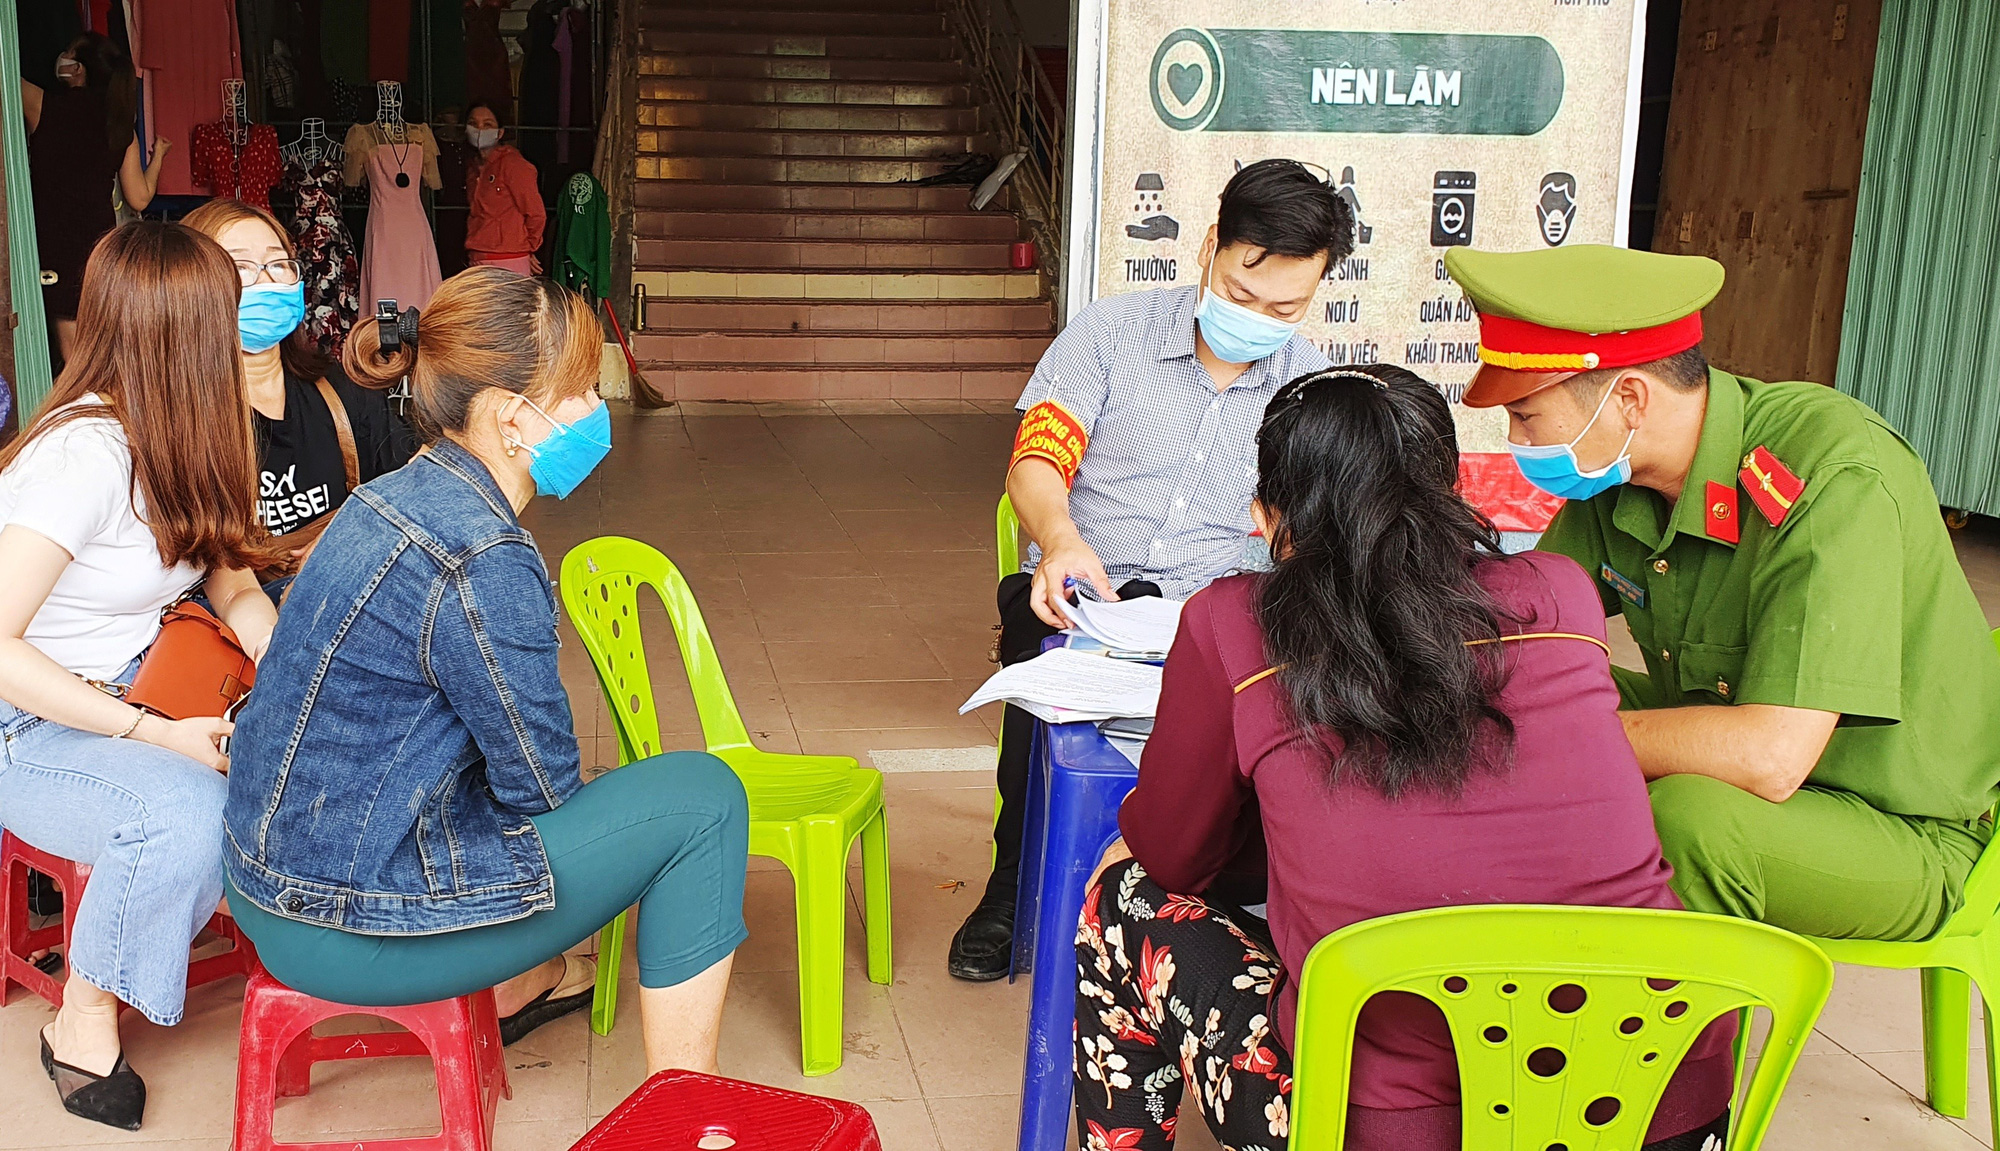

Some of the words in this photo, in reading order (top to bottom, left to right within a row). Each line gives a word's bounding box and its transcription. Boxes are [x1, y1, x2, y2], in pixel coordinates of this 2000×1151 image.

[1311, 61, 1378, 105] NÊN
[1125, 254, 1177, 282] THƯỜNG
[1325, 301, 1346, 323] NƠI
[1349, 294, 1359, 323] Ở
[260, 464, 297, 498] SAY
[255, 484, 330, 526] HEESE!
